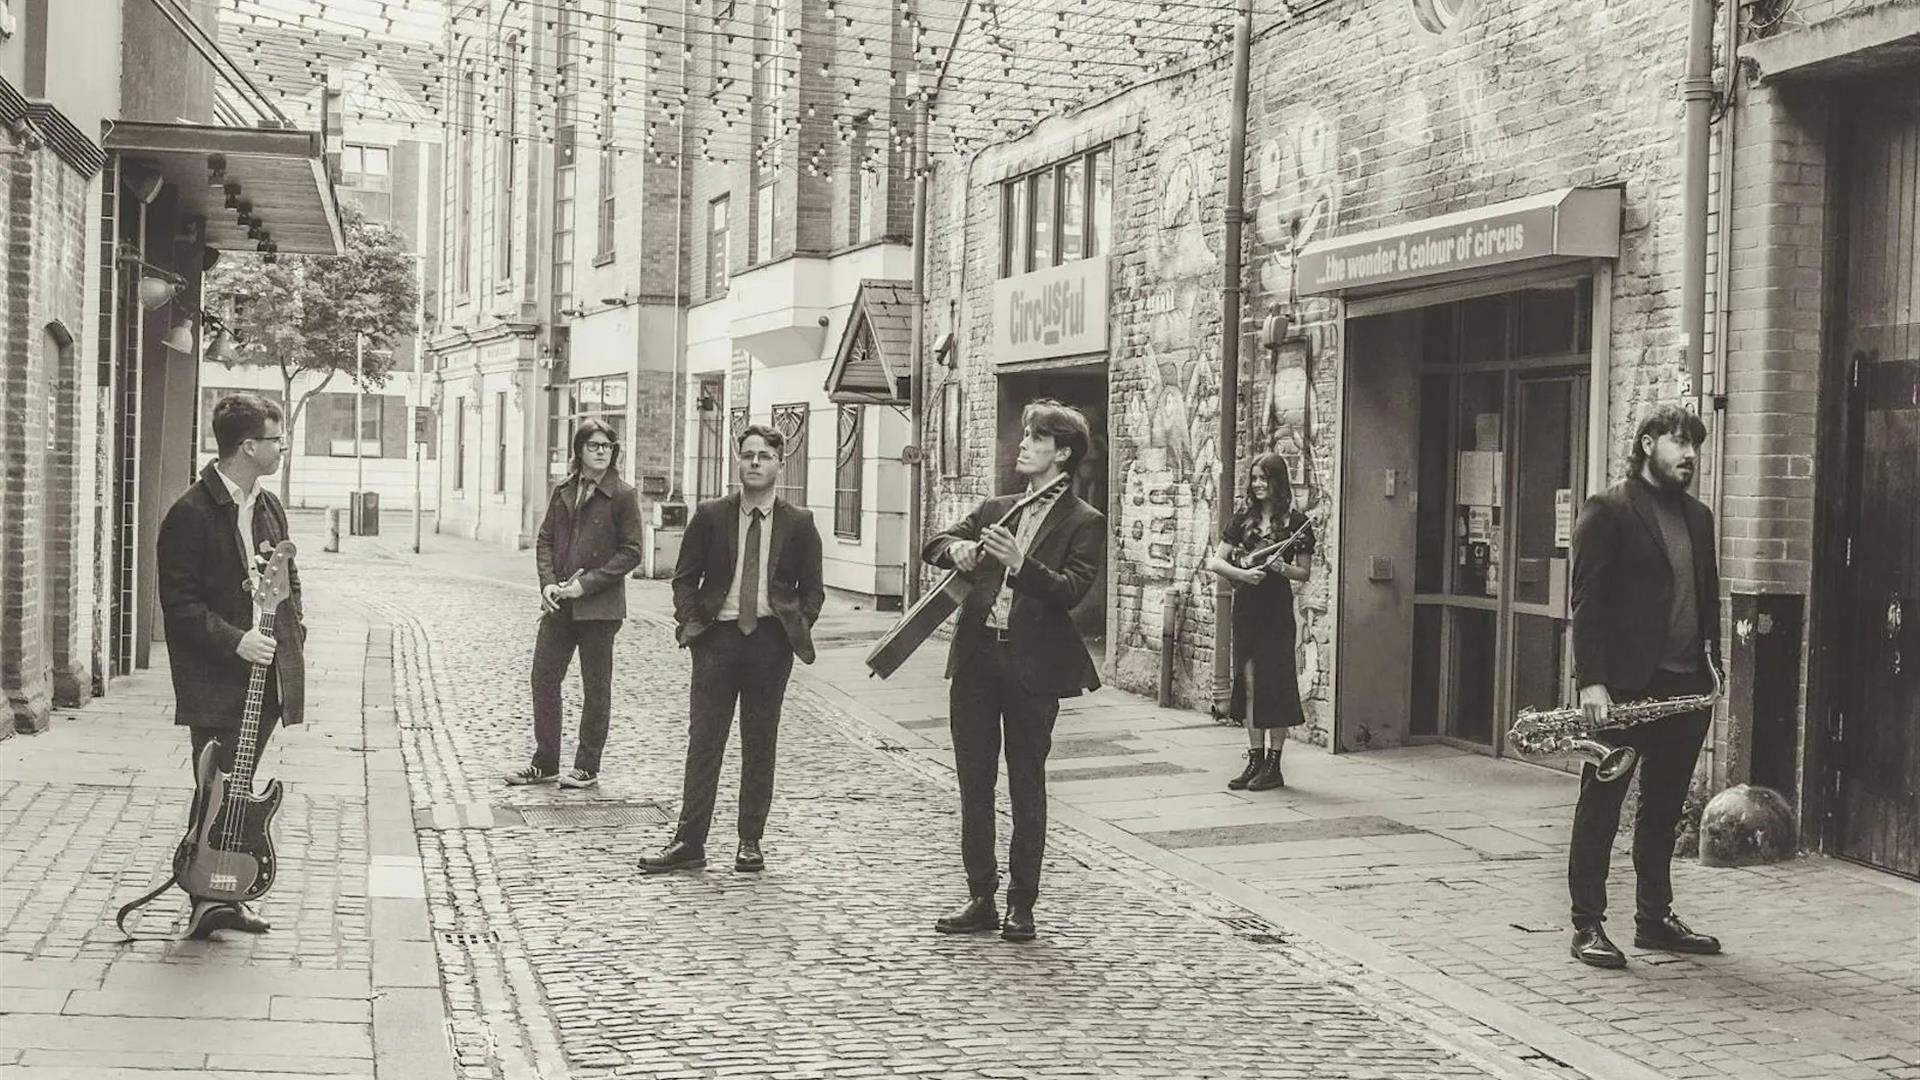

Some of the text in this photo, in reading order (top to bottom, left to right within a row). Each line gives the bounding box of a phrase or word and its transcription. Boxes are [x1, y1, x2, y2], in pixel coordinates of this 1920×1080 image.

[1347, 246, 1396, 279] wonder
[1398, 240, 1408, 271] &
[1410, 234, 1455, 270] colour
[1456, 227, 1473, 261] of
[1474, 222, 1525, 258] circus
